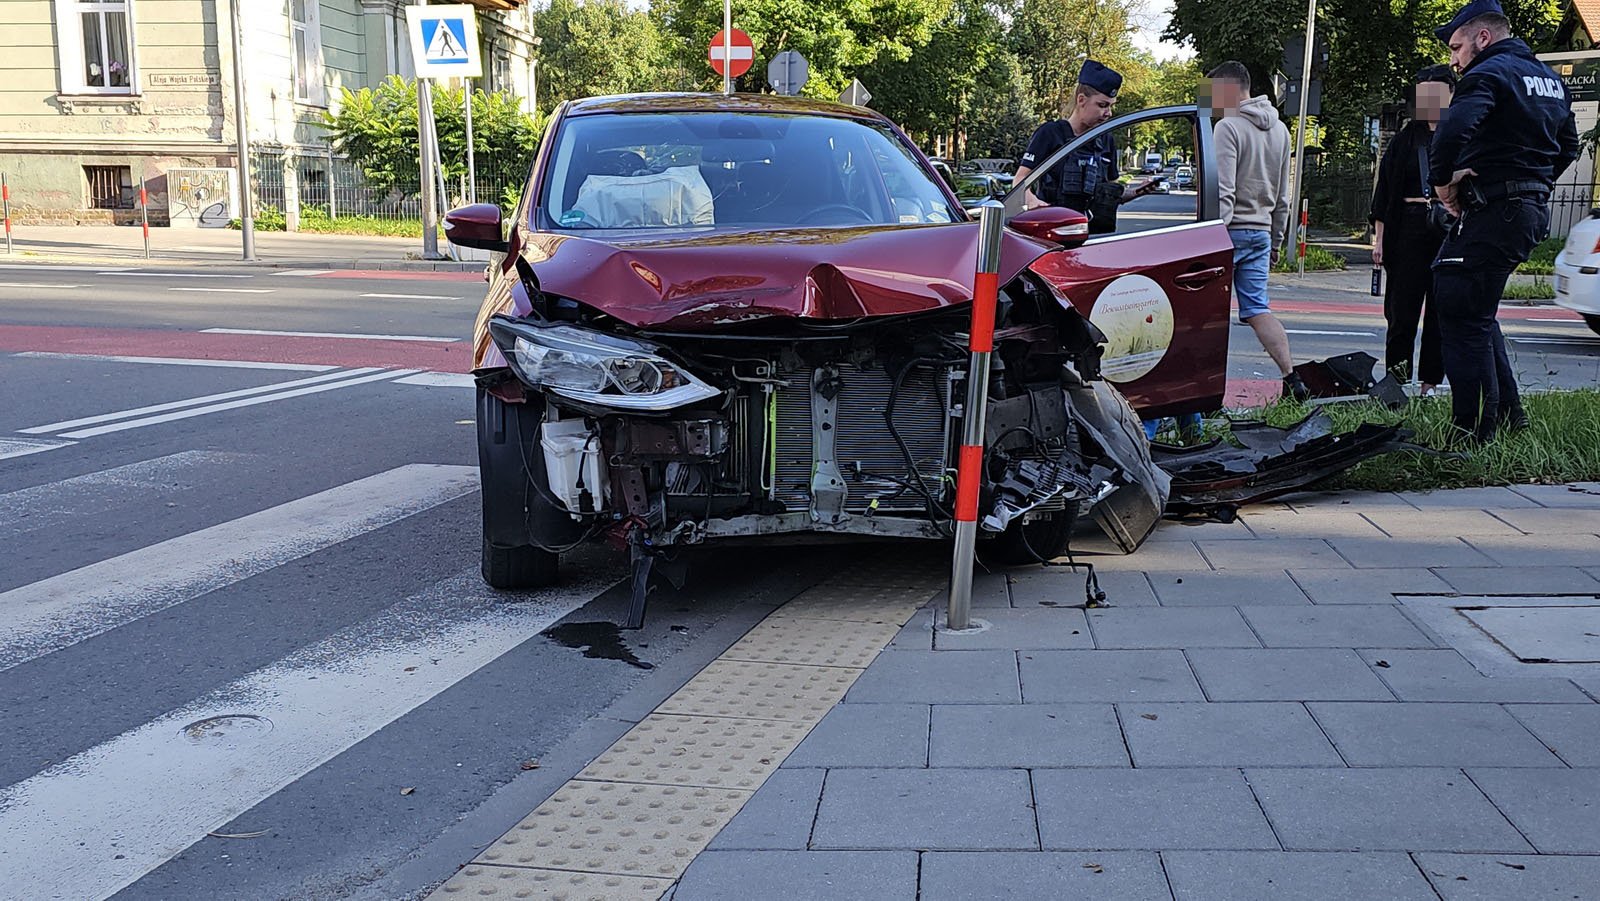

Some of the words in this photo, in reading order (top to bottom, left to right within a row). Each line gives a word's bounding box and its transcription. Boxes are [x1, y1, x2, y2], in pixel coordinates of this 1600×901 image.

[153, 76, 167, 84] Aleja
[169, 76, 188, 84] Wojska
[190, 75, 215, 84] Polskiego
